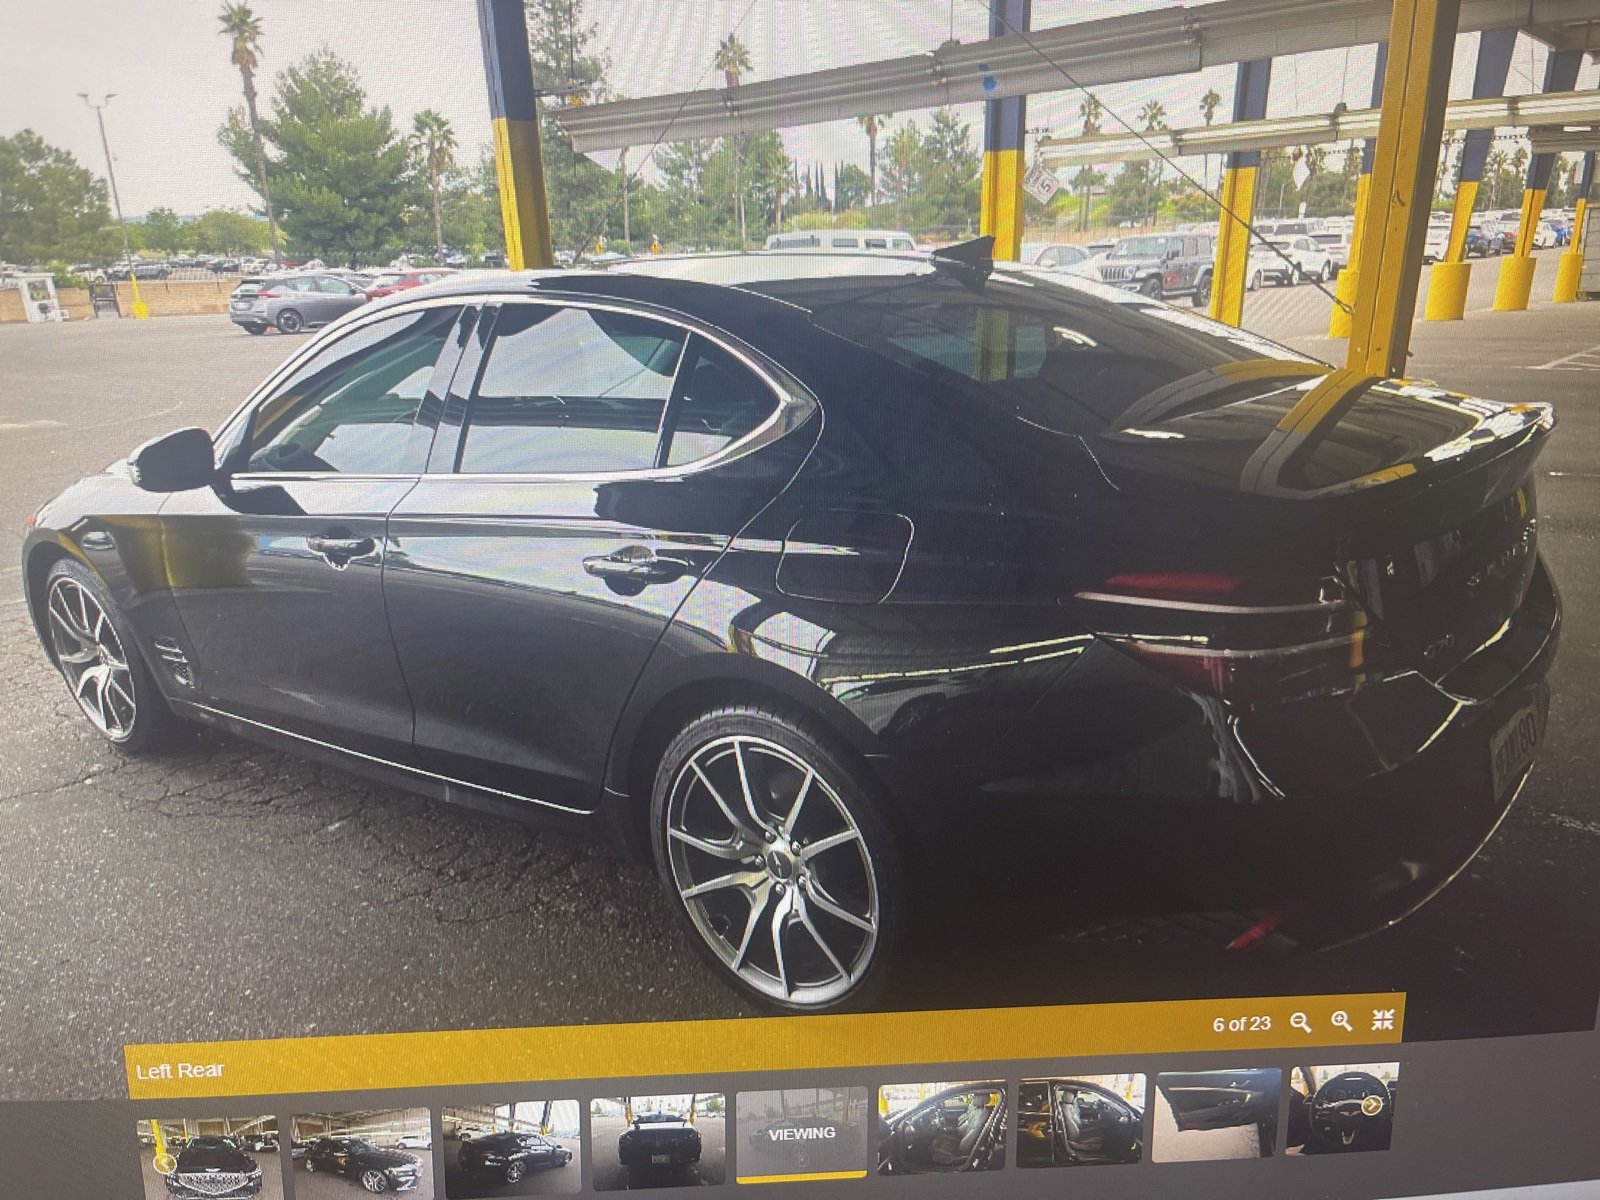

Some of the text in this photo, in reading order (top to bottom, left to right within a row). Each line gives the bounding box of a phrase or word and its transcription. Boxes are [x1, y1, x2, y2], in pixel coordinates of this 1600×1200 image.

[1213, 1015, 1272, 1032] 6 of 23
[135, 1062, 225, 1080] Left Rear
[768, 1126, 836, 1141] VIEWING
